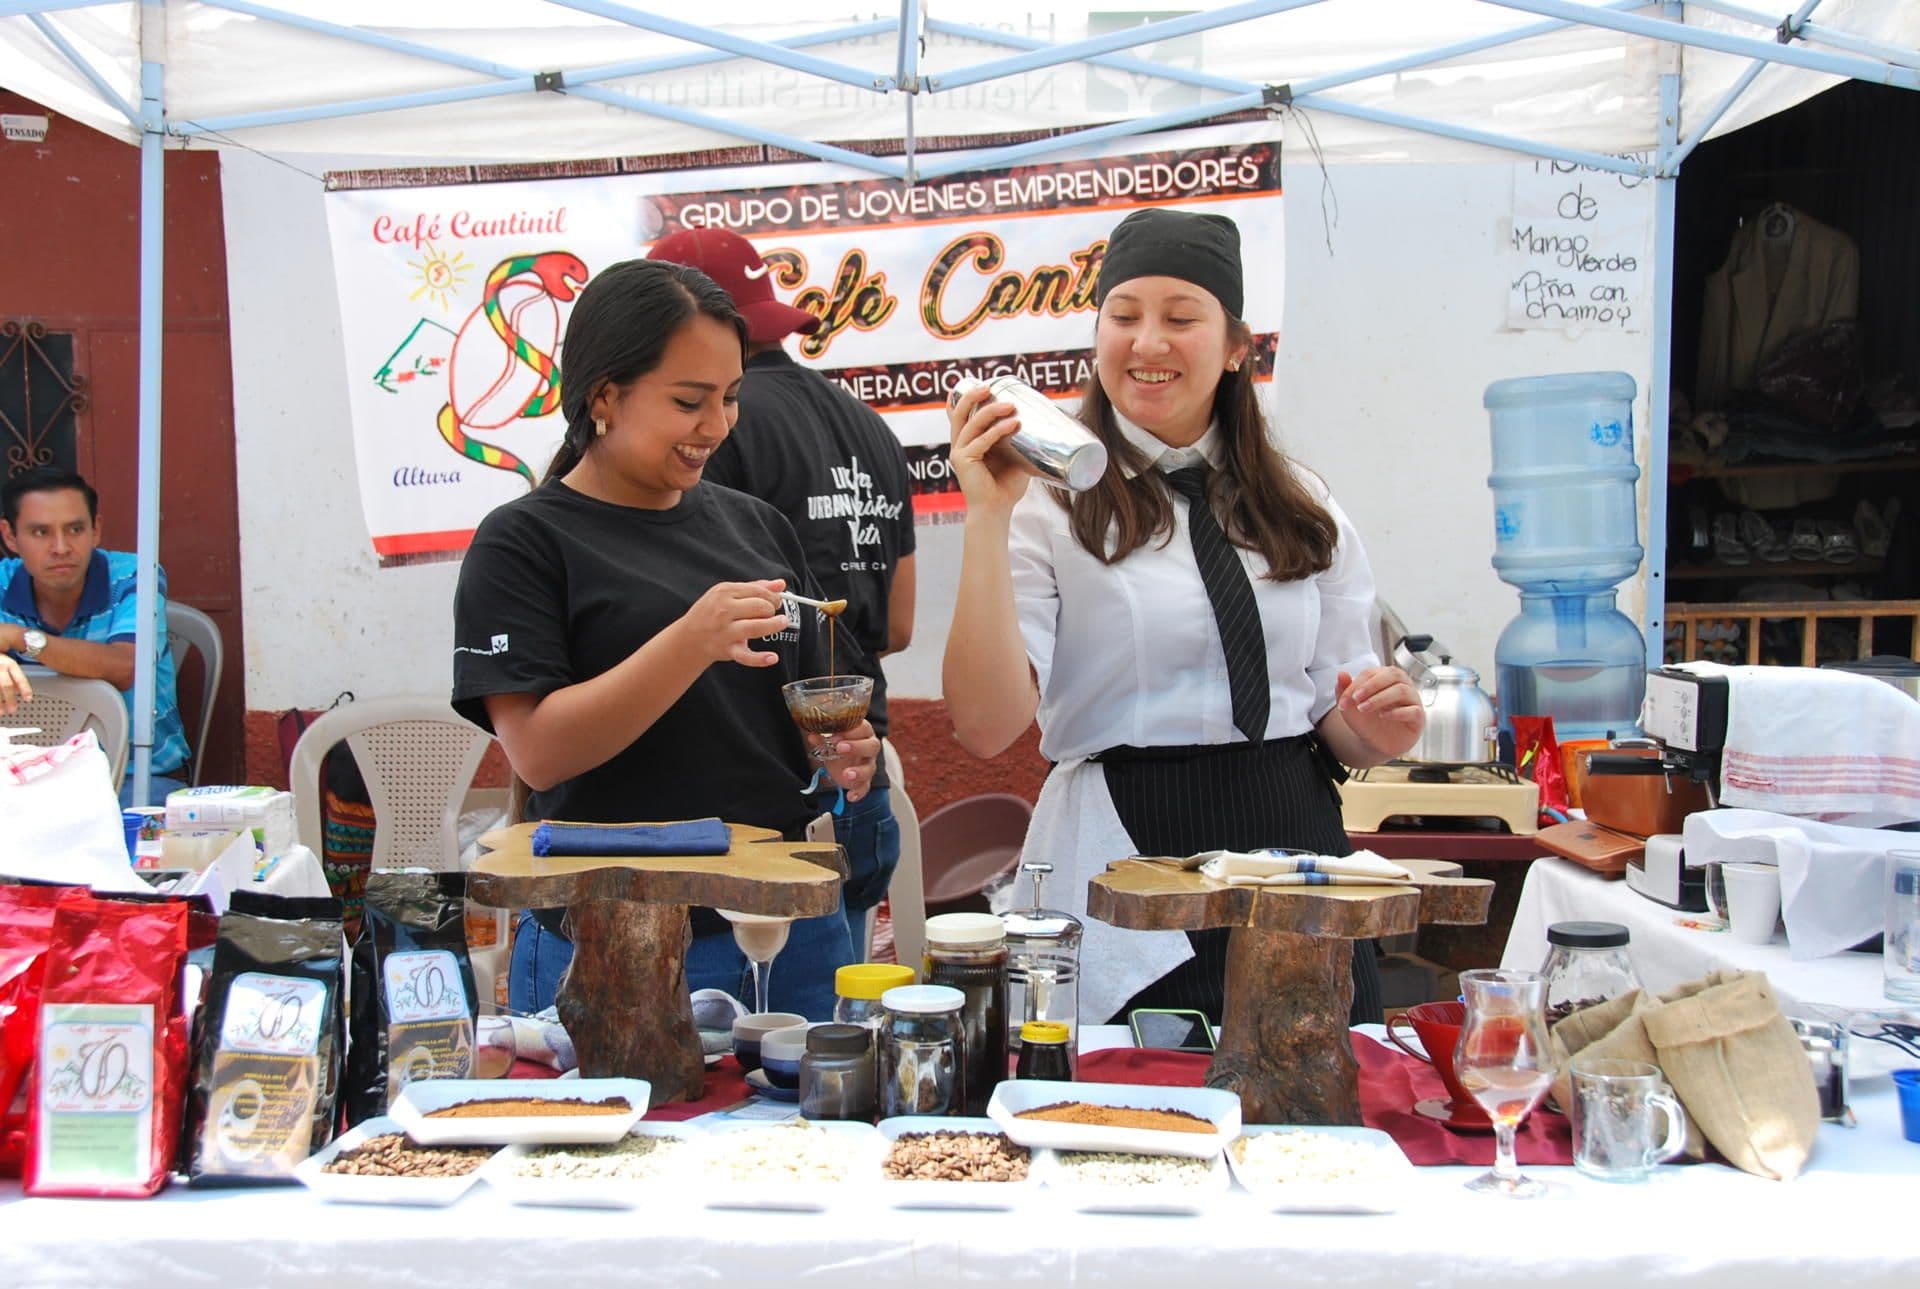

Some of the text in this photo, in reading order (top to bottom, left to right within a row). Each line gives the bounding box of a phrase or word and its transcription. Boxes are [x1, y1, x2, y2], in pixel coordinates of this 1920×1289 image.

[4, 127, 45, 138] CENSADO
[679, 155, 1259, 229] GRUPO DE JOVENES EMPRENDEDORES
[1557, 181, 1598, 221] de
[373, 206, 567, 251] Café Cantinil
[1514, 225, 1588, 267] Mango
[1576, 252, 1637, 272] Verde
[1523, 270, 1575, 302] Piña
[829, 362, 983, 400] NERACIÓN
[393, 466, 461, 487] Altura
